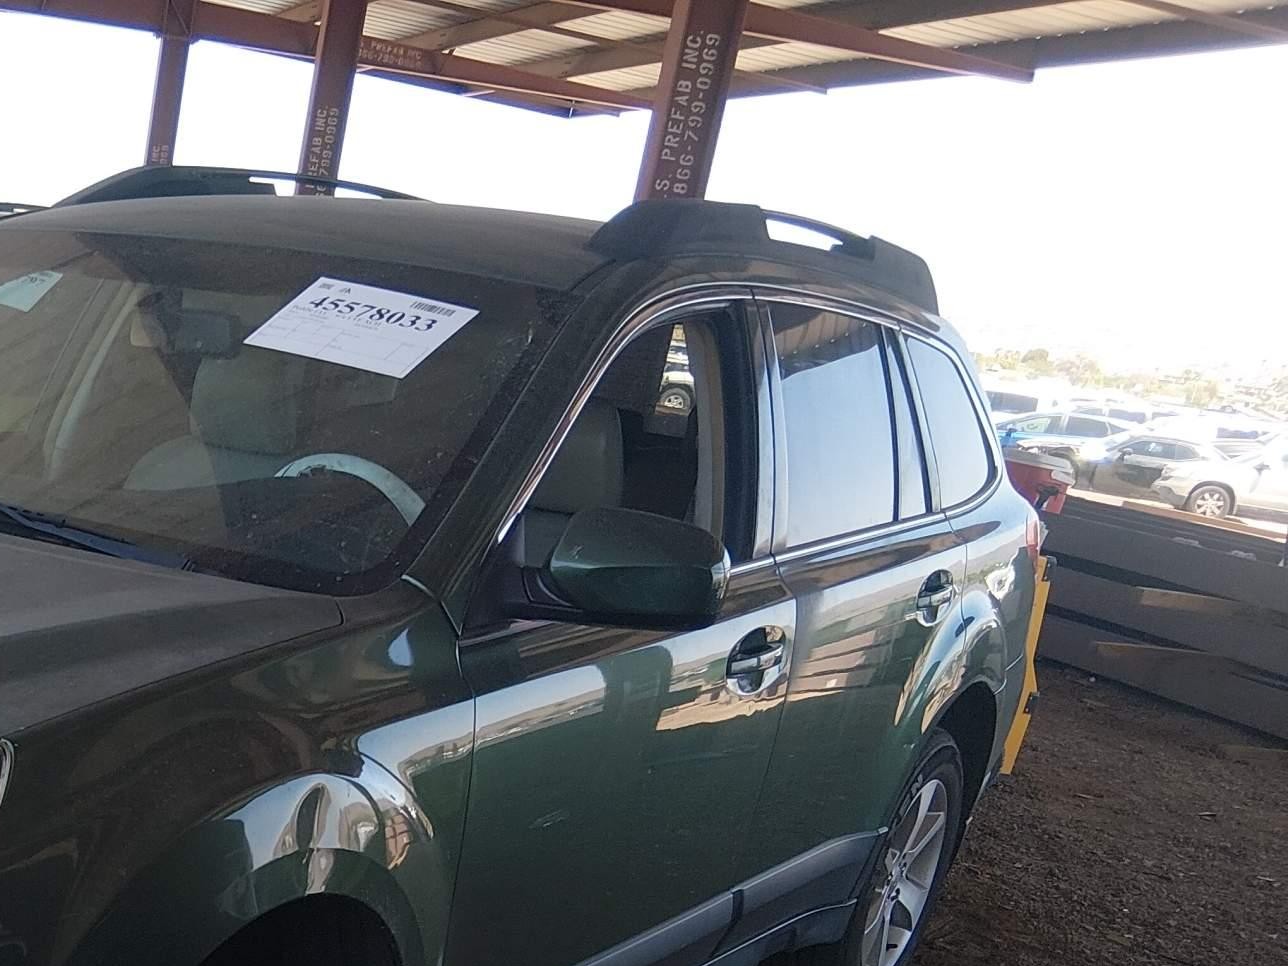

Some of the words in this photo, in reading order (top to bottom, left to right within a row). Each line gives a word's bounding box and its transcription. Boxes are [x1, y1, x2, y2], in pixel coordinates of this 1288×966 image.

[314, 105, 329, 131] INC.
[661, 79, 692, 162] PREFAB
[681, 30, 705, 70] INC.
[673, 33, 721, 194] 866-799-0969
[309, 296, 438, 332] 45578033
